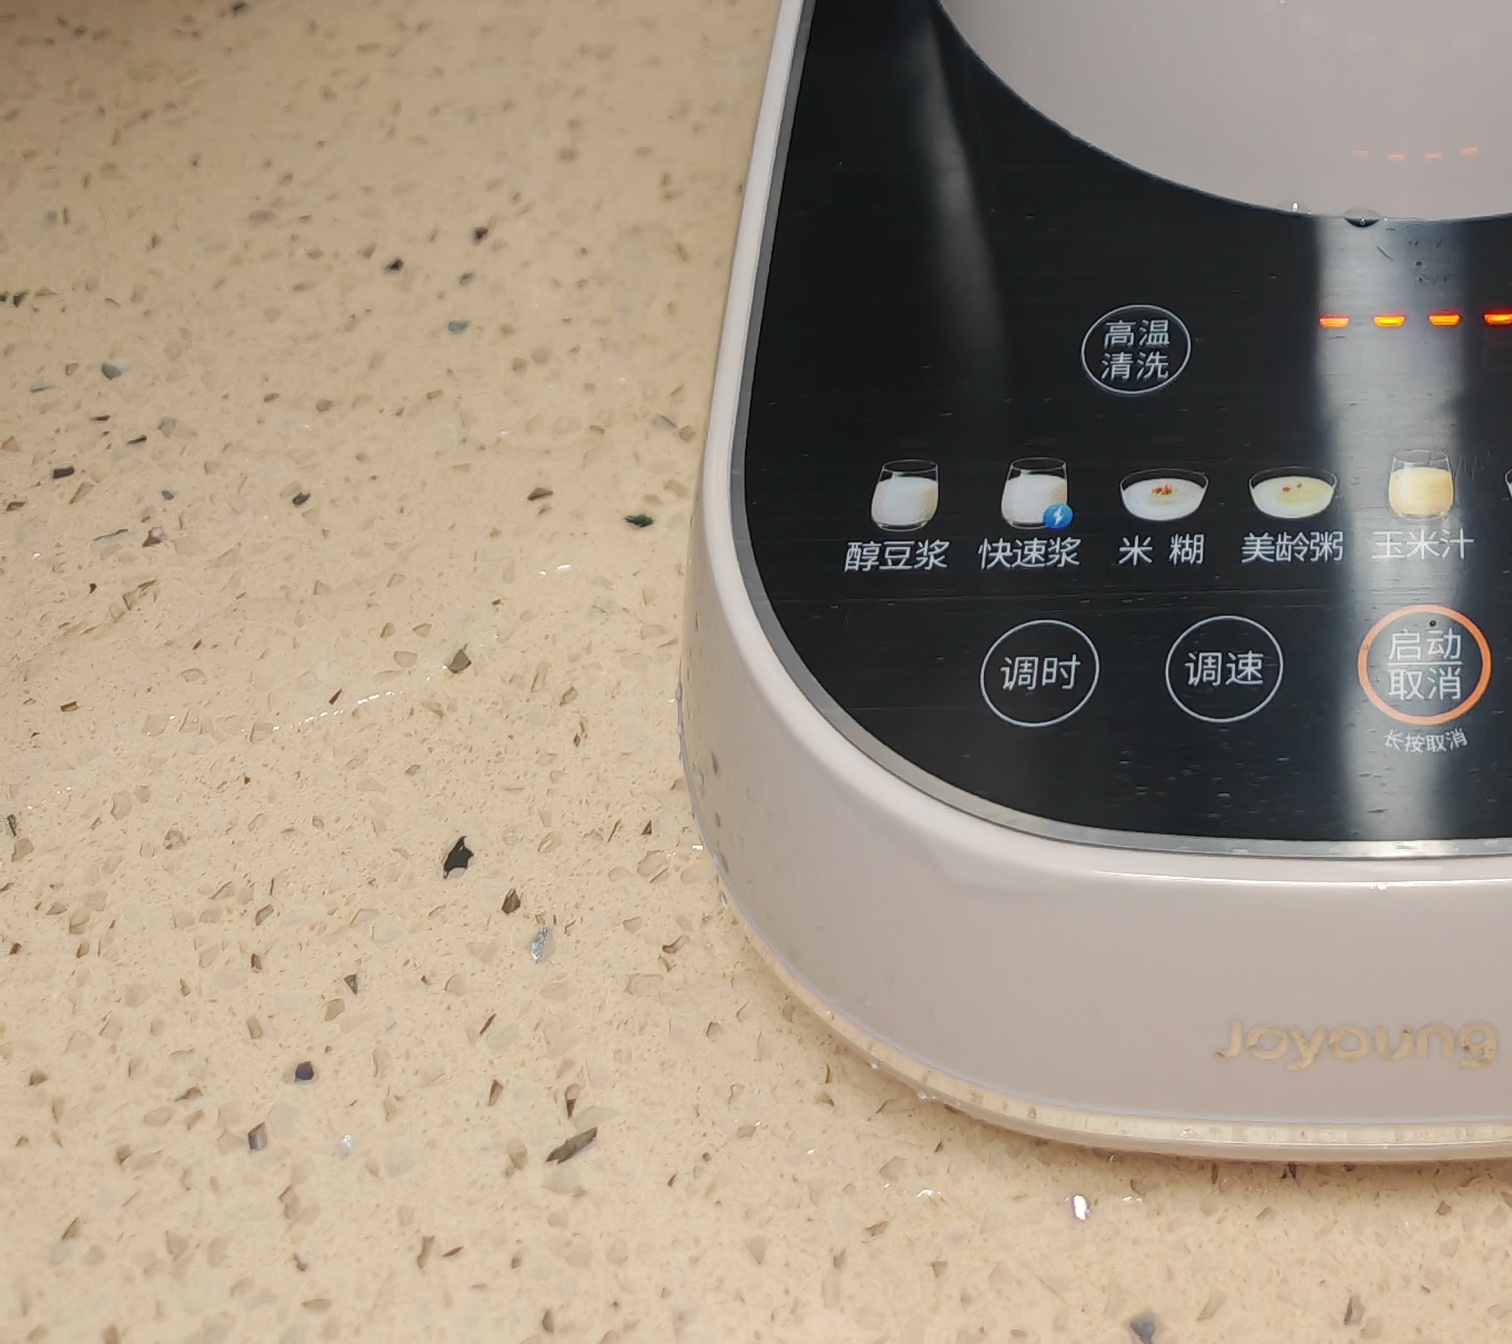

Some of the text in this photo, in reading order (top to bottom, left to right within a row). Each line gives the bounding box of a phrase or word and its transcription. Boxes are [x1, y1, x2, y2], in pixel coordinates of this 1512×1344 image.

[1104, 318, 1170, 348] 高温
[1101, 351, 1170, 381] 清洗
[844, 539, 950, 573] 醇豆浆
[977, 537, 1082, 570] 快速浆
[1241, 529, 1344, 564] 美龄粥
[1371, 527, 1475, 561] 玉米汁
[1387, 627, 1463, 661] 启动
[1000, 654, 1082, 691] 调时
[1184, 650, 1265, 688] 调速
[1387, 667, 1463, 701] 取消
[1384, 726, 1469, 754] 长按取消
[1213, 1016, 1498, 1071] Joyoung
